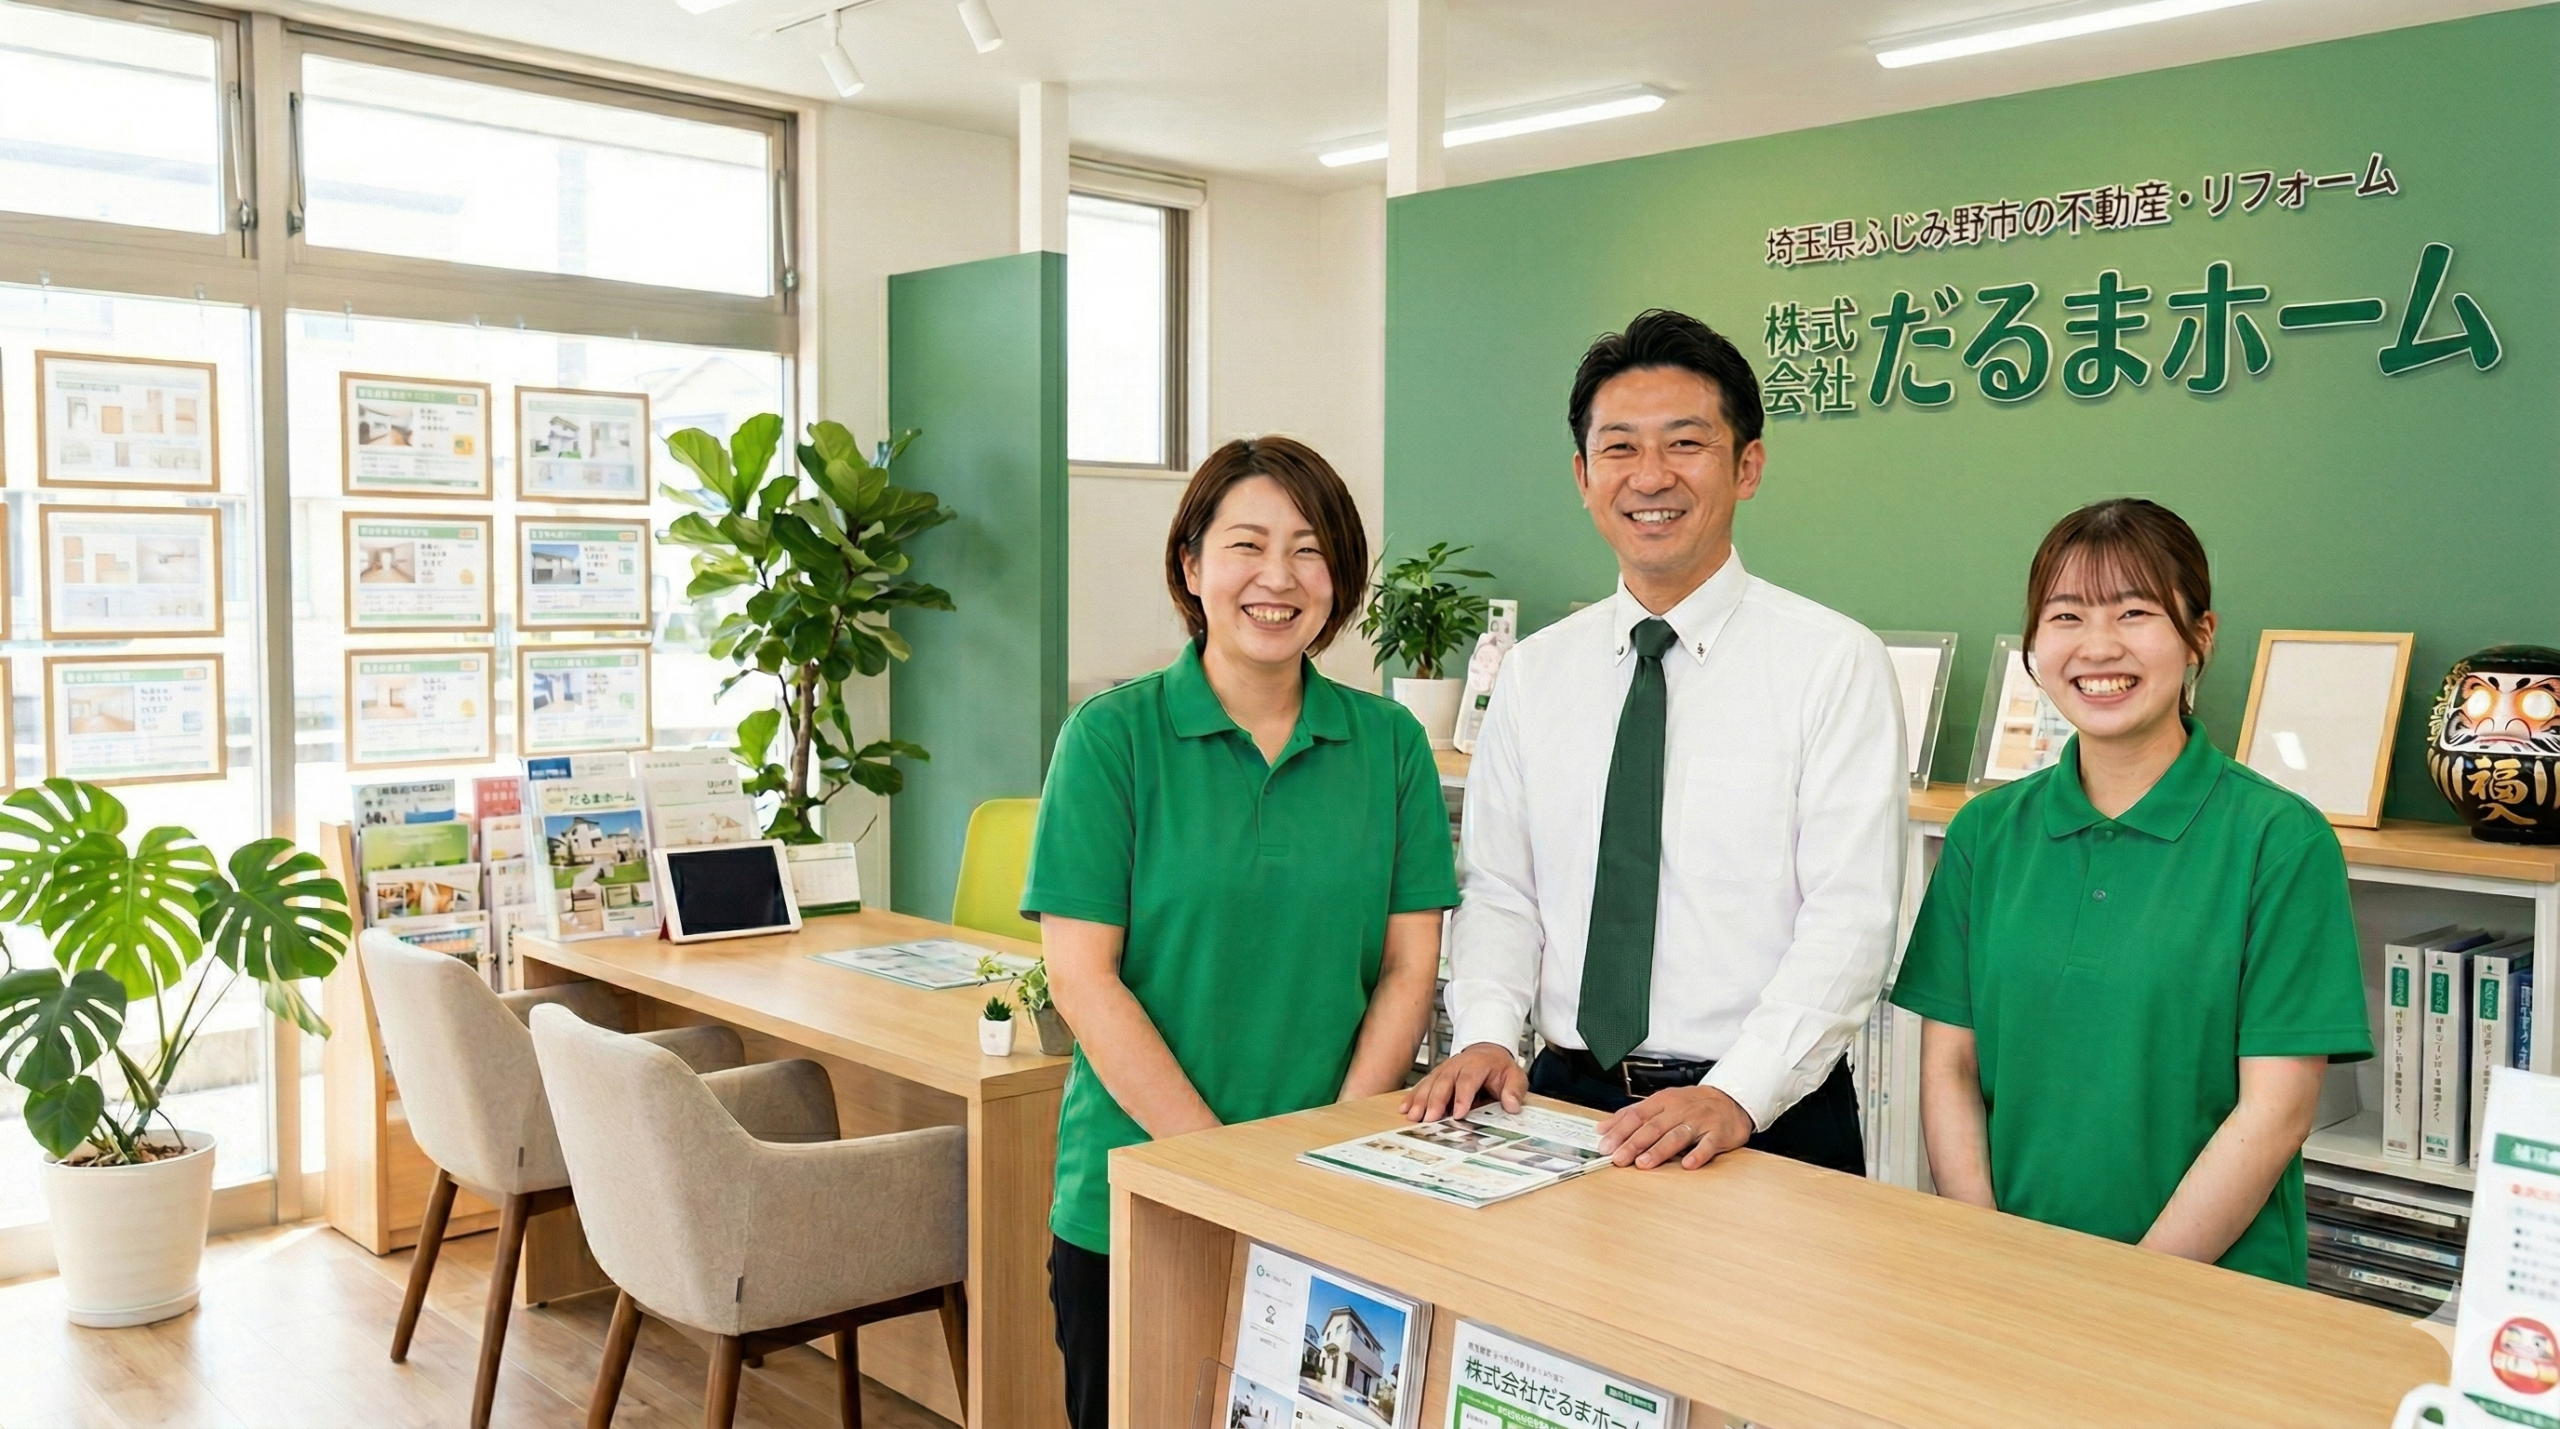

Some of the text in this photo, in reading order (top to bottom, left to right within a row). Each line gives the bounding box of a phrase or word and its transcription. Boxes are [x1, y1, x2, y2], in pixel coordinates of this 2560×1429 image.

[1765, 152, 2400, 266] 埼玉県ふじみ野市の不動産・リフォーム
[1764, 296, 1858, 355] 株式
[1868, 242, 2503, 406] だるまホーム
[1764, 356, 1858, 415] 会社
